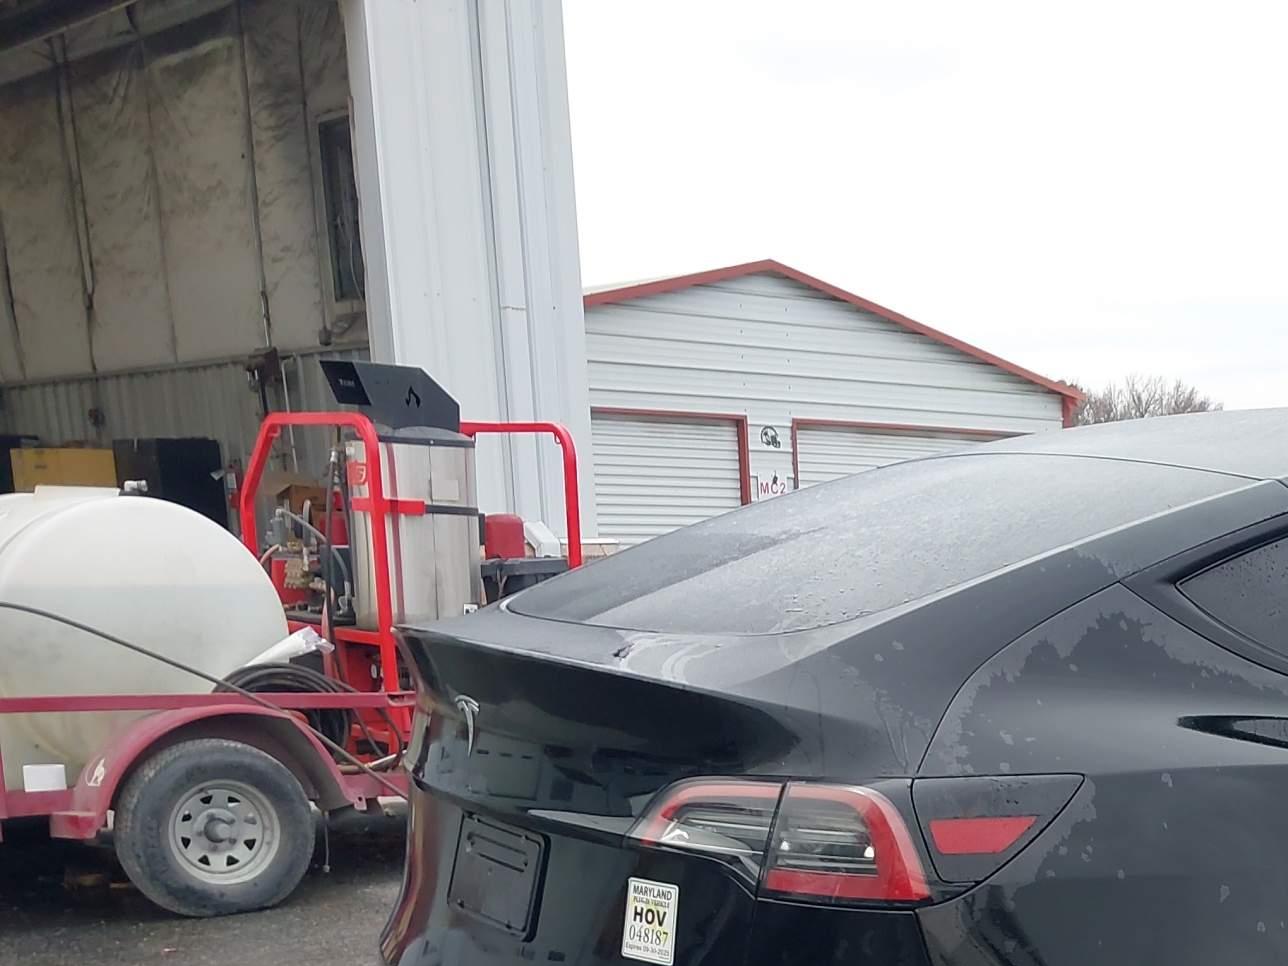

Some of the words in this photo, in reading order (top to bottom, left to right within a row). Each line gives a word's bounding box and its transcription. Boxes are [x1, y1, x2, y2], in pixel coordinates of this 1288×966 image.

[632, 885, 673, 901] MARYLAND
[632, 905, 667, 927] HOV
[628, 924, 669, 947] 048187
